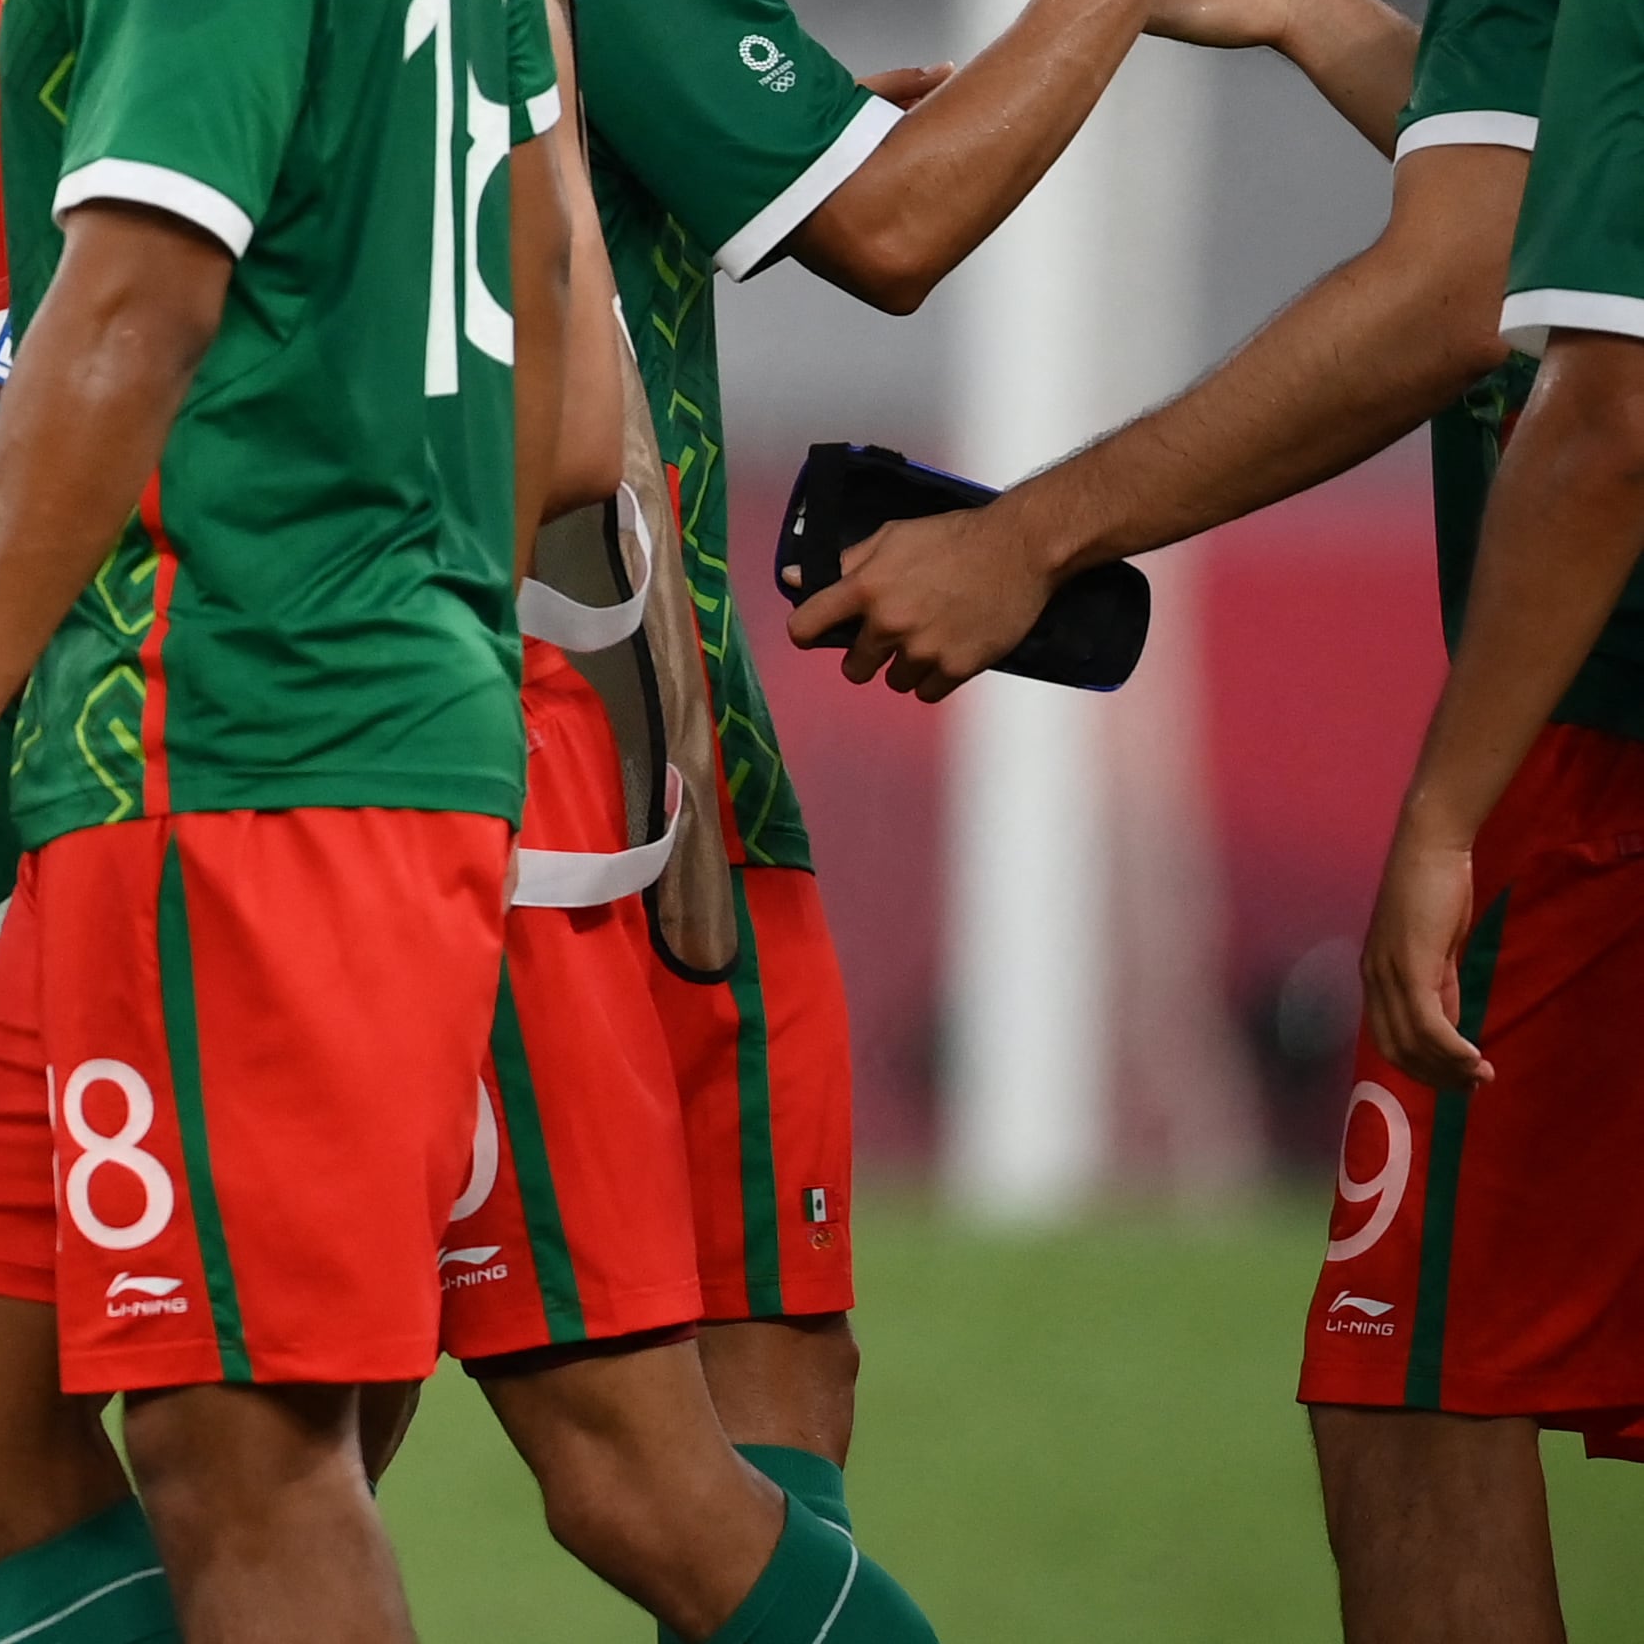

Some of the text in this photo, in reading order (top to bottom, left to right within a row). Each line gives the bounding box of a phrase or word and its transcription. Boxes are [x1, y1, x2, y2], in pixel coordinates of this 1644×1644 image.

[46, 1057, 175, 1252] 8
[441, 1263, 509, 1292] I-NING
[1325, 1318, 1395, 1337] LI-NING
